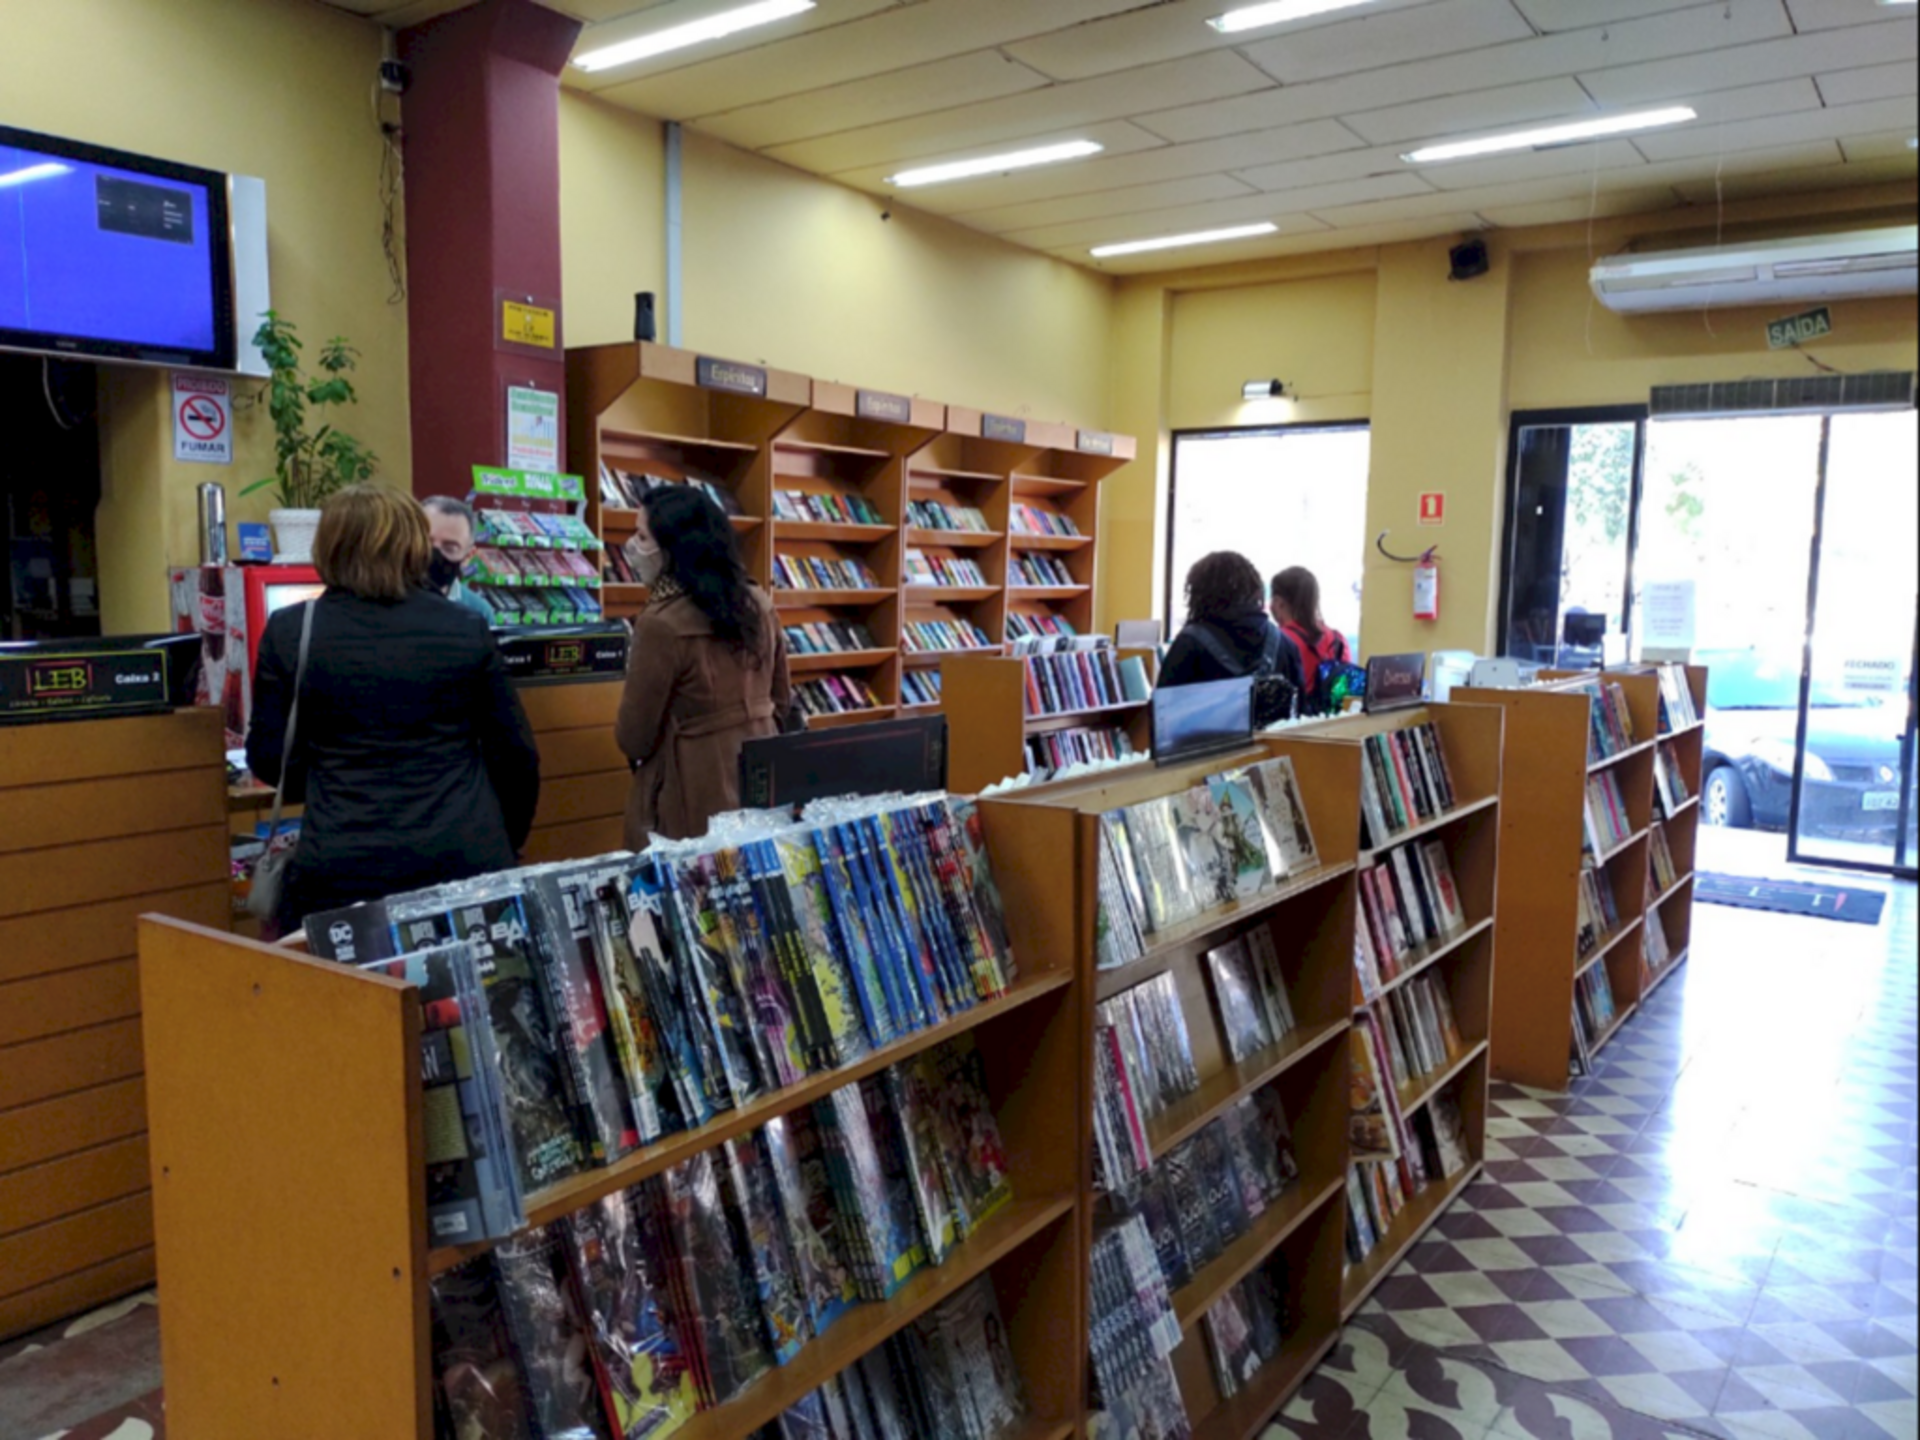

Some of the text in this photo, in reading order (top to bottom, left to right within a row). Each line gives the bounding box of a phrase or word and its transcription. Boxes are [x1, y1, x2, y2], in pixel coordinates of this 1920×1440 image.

[181, 441, 225, 453] FUMAR
[548, 645, 579, 662] LEB
[1844, 660, 1895, 670] FECHADO
[34, 667, 87, 691] LEB
[115, 673, 149, 685] Caixa
